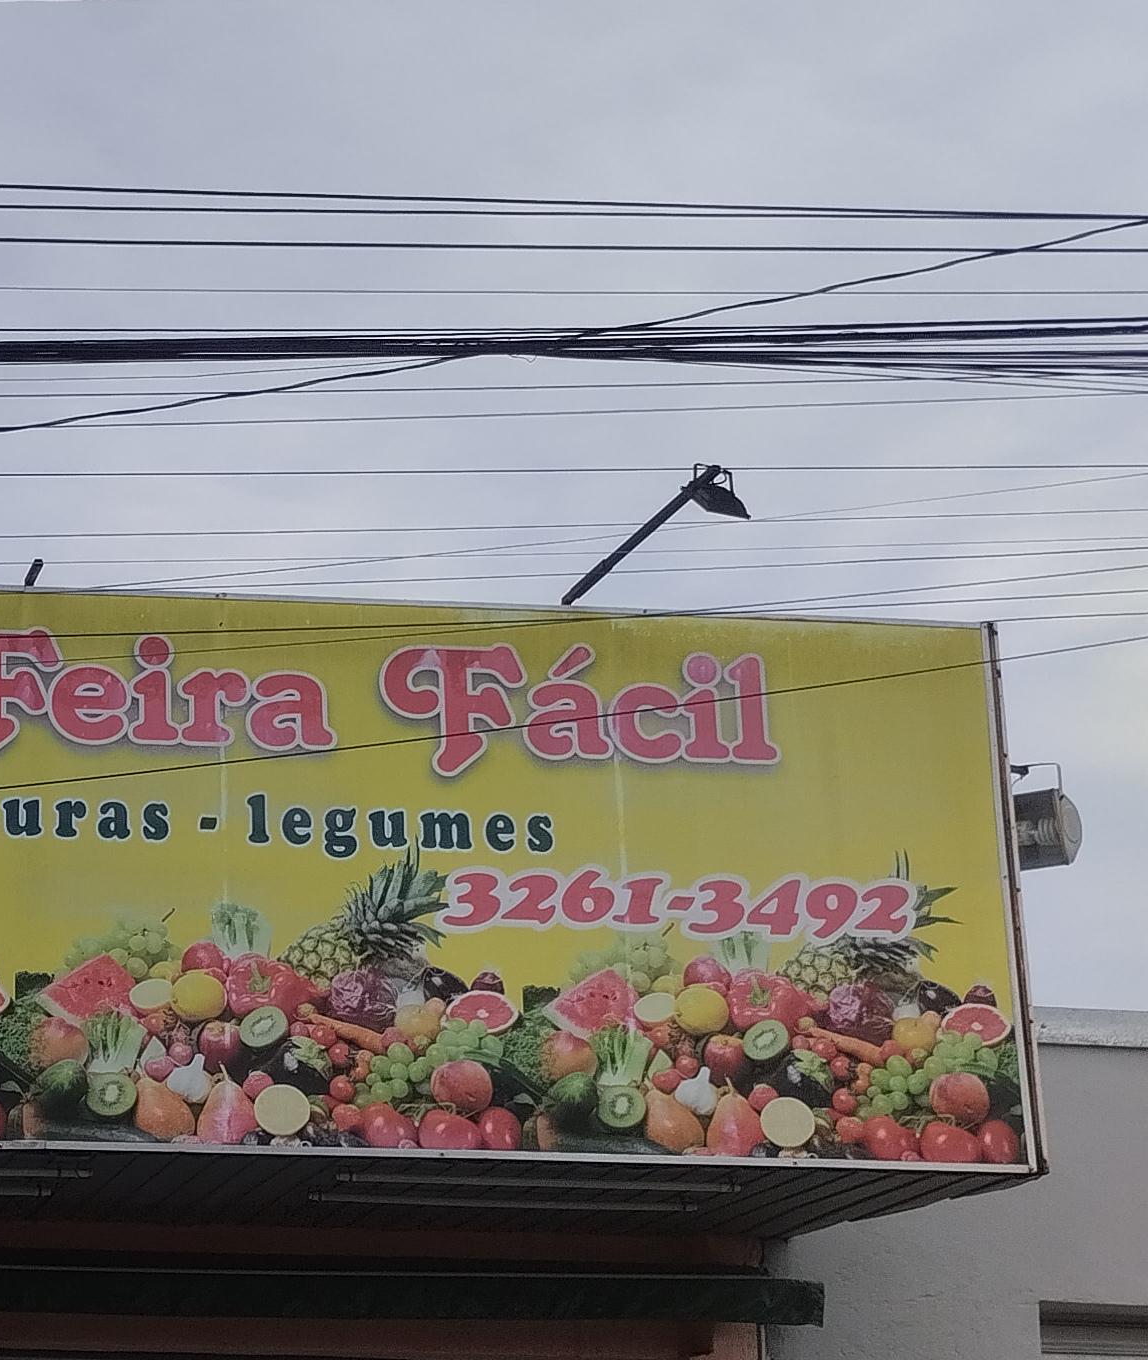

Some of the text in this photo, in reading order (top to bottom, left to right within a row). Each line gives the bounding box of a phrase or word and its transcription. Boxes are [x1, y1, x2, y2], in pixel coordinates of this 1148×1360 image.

[380, 643, 781, 777] Fácil
[246, 793, 554, 858] legumes
[441, 869, 911, 938] 3261-3492
